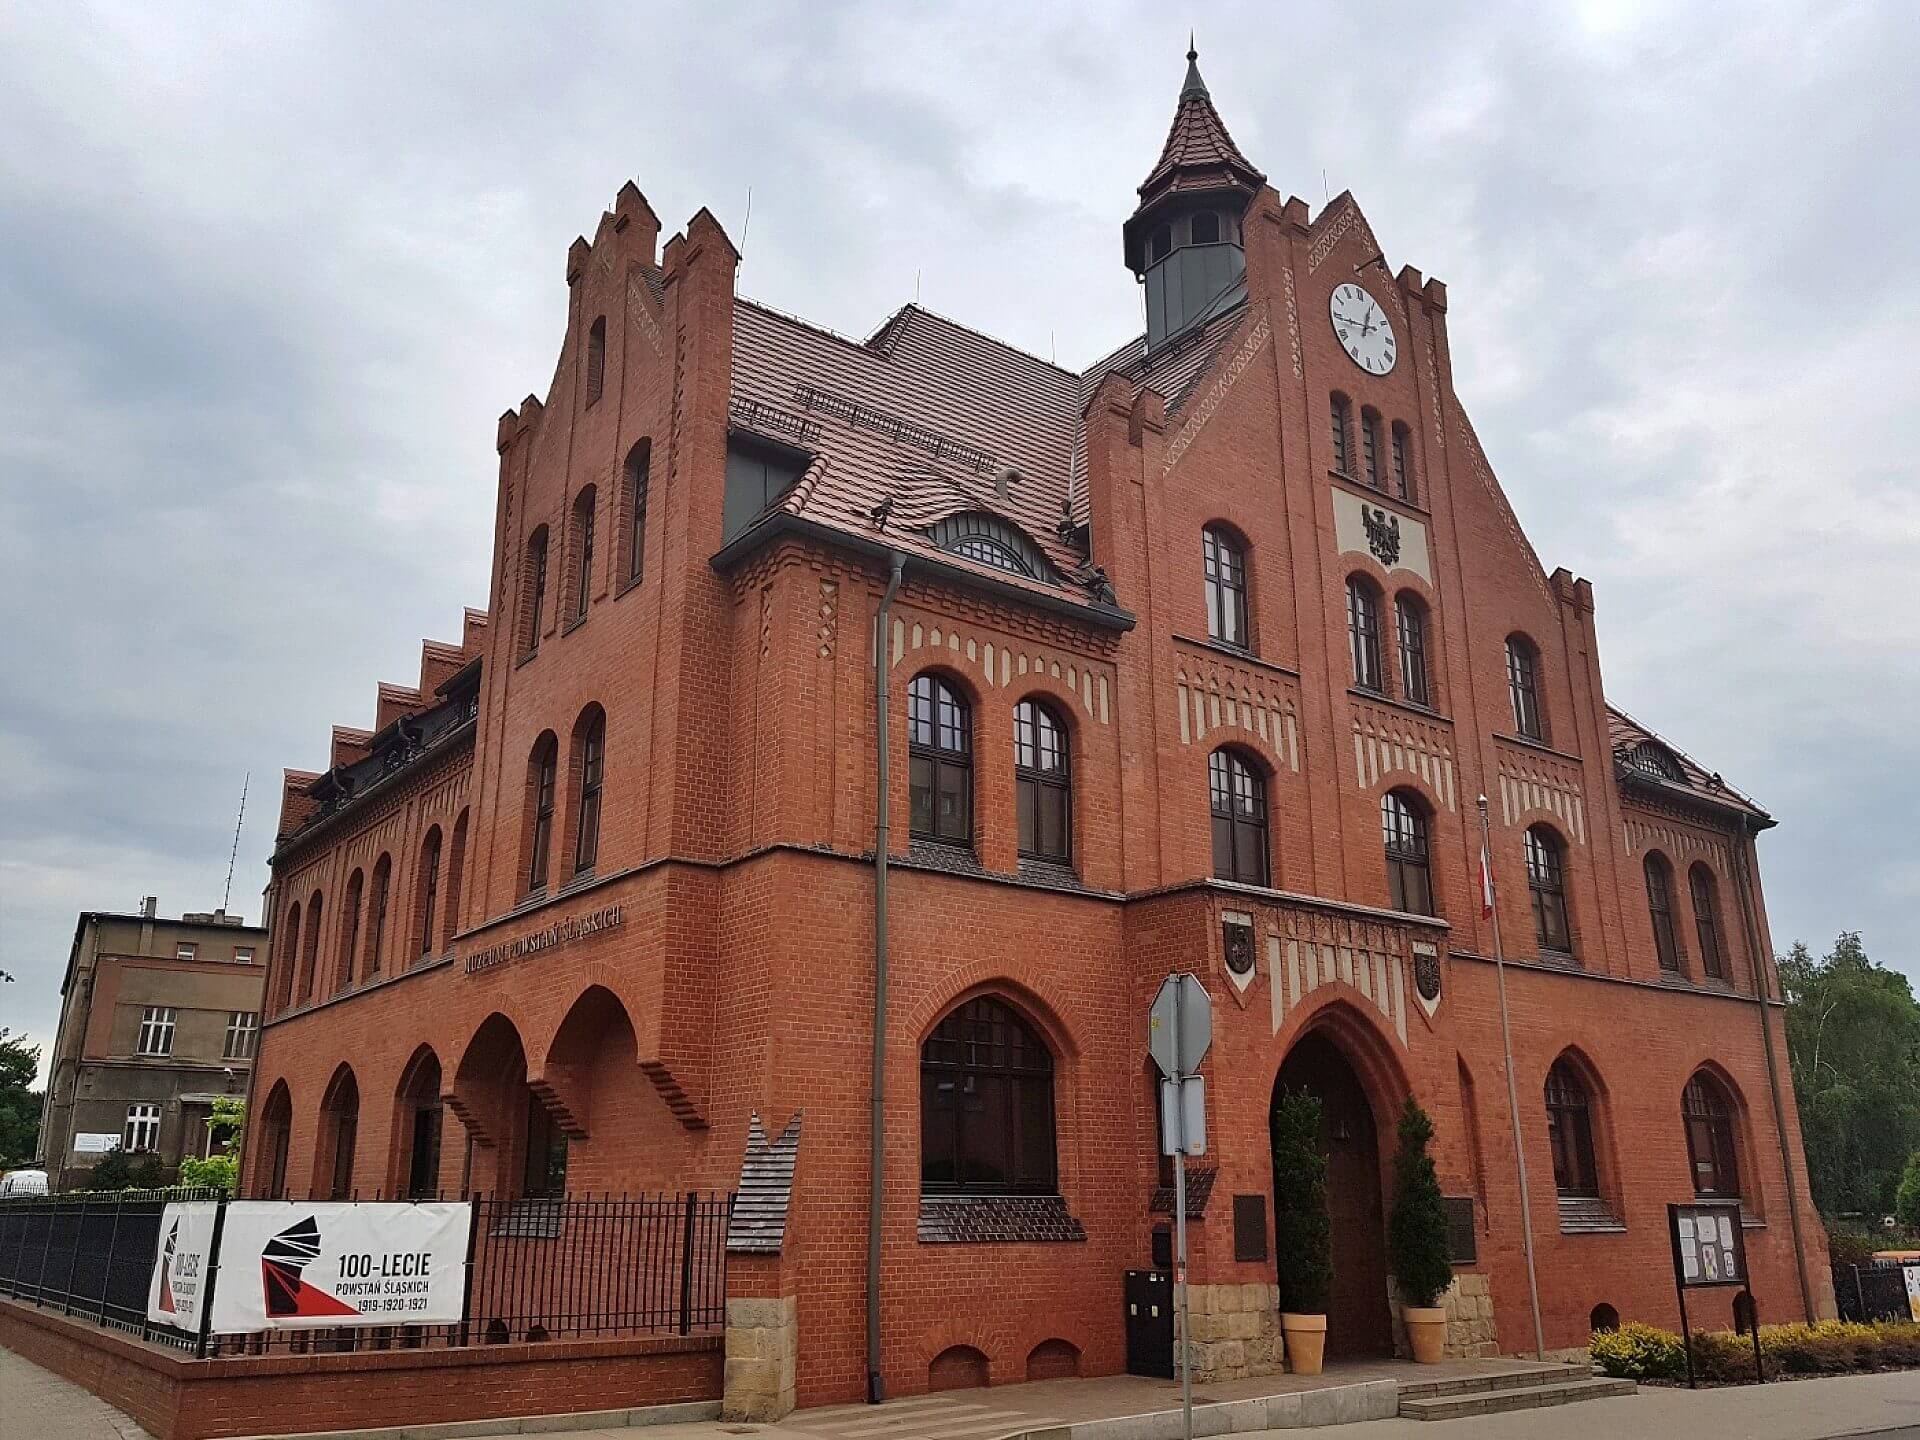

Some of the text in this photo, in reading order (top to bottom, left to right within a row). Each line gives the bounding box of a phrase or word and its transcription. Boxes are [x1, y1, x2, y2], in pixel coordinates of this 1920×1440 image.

[561, 905, 621, 940] ŚLĄSKICH
[339, 1253, 432, 1278] 100-LECIE
[336, 1280, 429, 1296] POWSTAŃ ŚLĄSKICH
[358, 1298, 428, 1312] 1919-1920-1921
